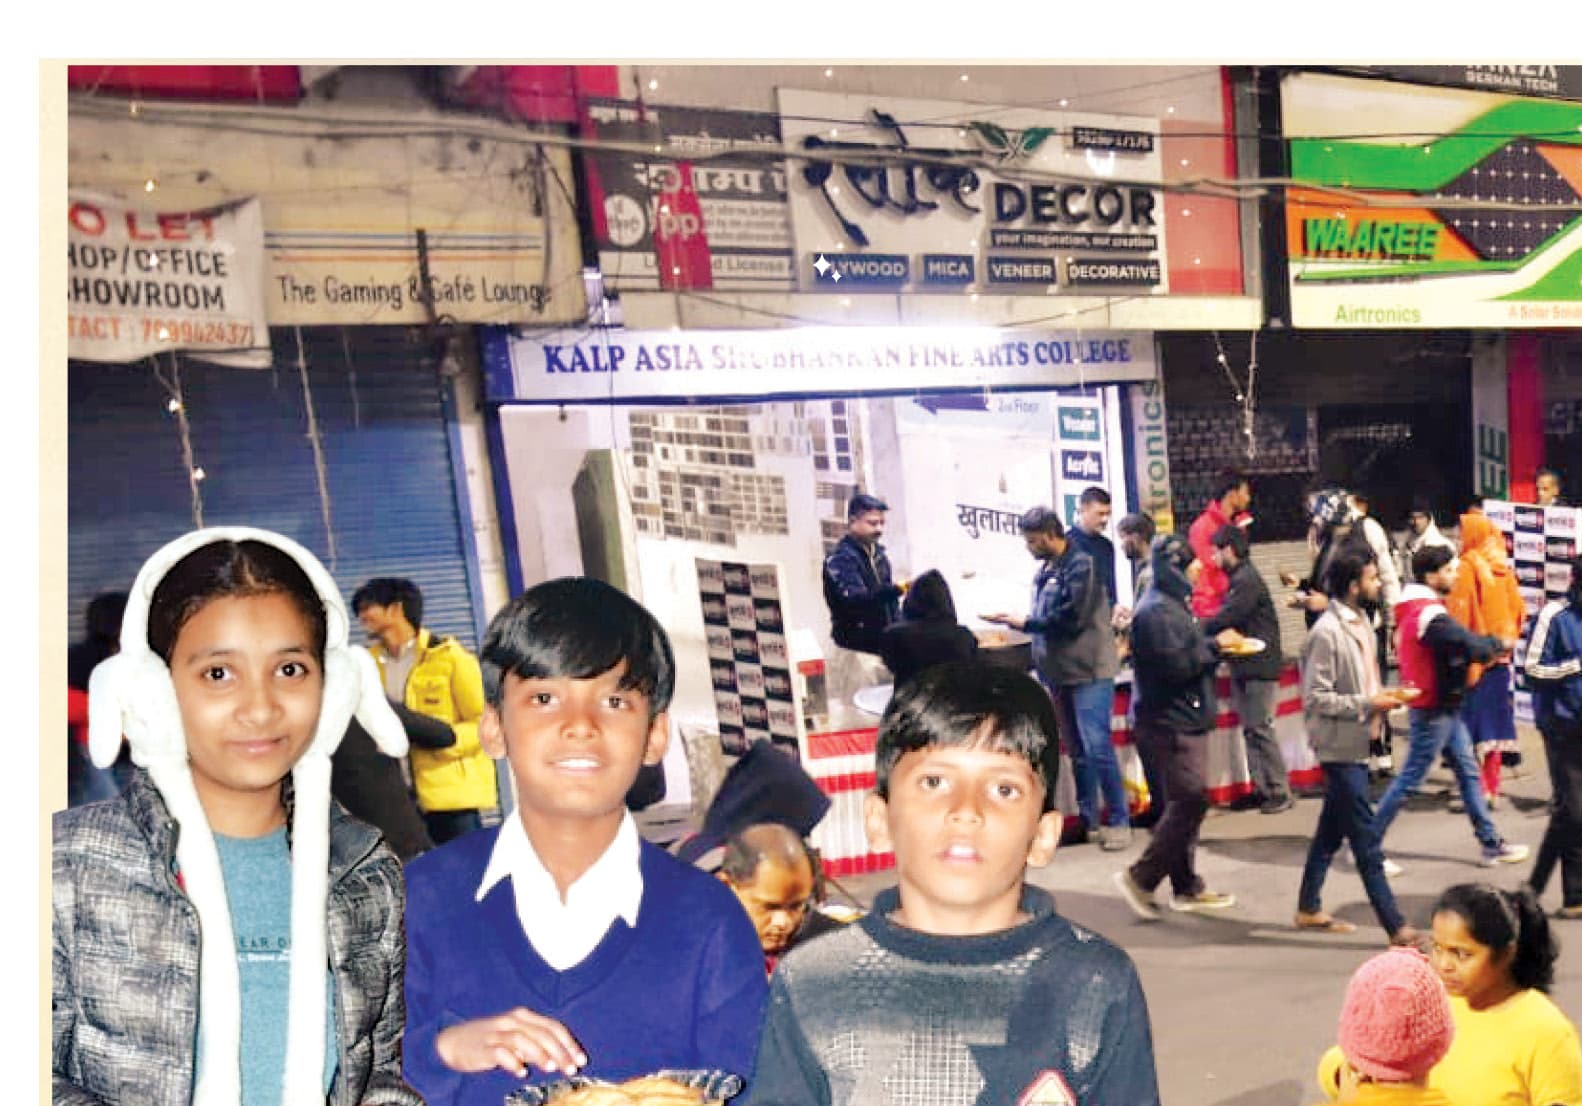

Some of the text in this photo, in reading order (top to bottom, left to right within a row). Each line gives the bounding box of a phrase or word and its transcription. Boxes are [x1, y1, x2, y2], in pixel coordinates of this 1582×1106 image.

[1526, 78, 1558, 92] TECH
[994, 183, 1156, 226] DECOR
[126, 208, 214, 241] LET
[1304, 218, 1444, 256] WAAREE
[815, 259, 1160, 281] LYWOOD MICA VENEER DECORATIVE
[68, 277, 225, 311] HOWROOM
[277, 275, 316, 304] The
[324, 274, 404, 311] Gaming
[482, 274, 553, 313] Lounge
[1335, 303, 1423, 324] Airtronics
[542, 344, 626, 374] KALP
[634, 343, 704, 372] ASIA
[909, 343, 964, 368] FINE
[969, 340, 1030, 367] ARTS
[1033, 338, 1132, 365] COLLEGE
[956, 503, 1025, 539] खुलासा
